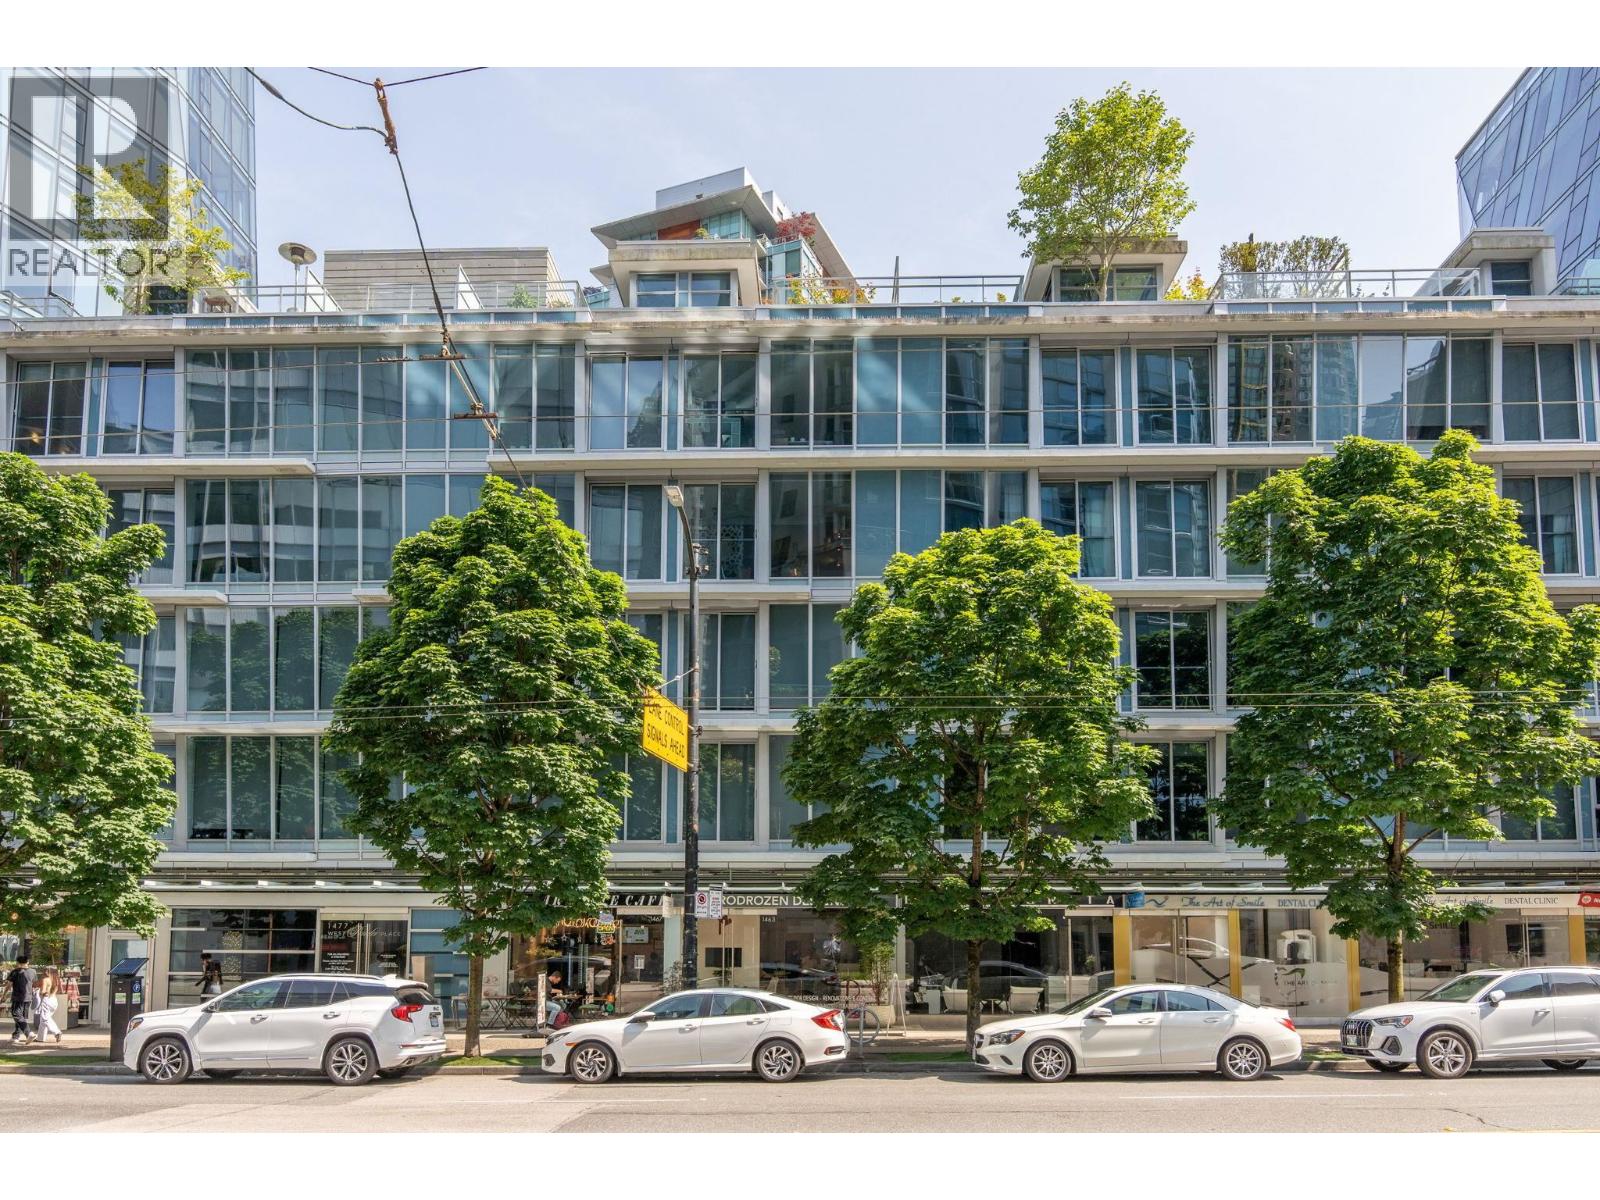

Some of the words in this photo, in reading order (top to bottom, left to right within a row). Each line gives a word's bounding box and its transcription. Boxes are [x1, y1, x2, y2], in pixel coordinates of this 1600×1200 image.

[664, 709, 684, 736] CONTROL
[646, 723, 668, 748] SIGNALS
[669, 737, 685, 758] AHEAD
[625, 895, 664, 906] CAF
[1181, 896, 1201, 907] The
[1203, 896, 1223, 907] Art
[1225, 896, 1236, 908] of
[1236, 896, 1265, 907] Smile
[1278, 899, 1306, 907] DENTAL
[1504, 897, 1533, 905] DENTAL
[1533, 897, 1559, 905] CLINIC
